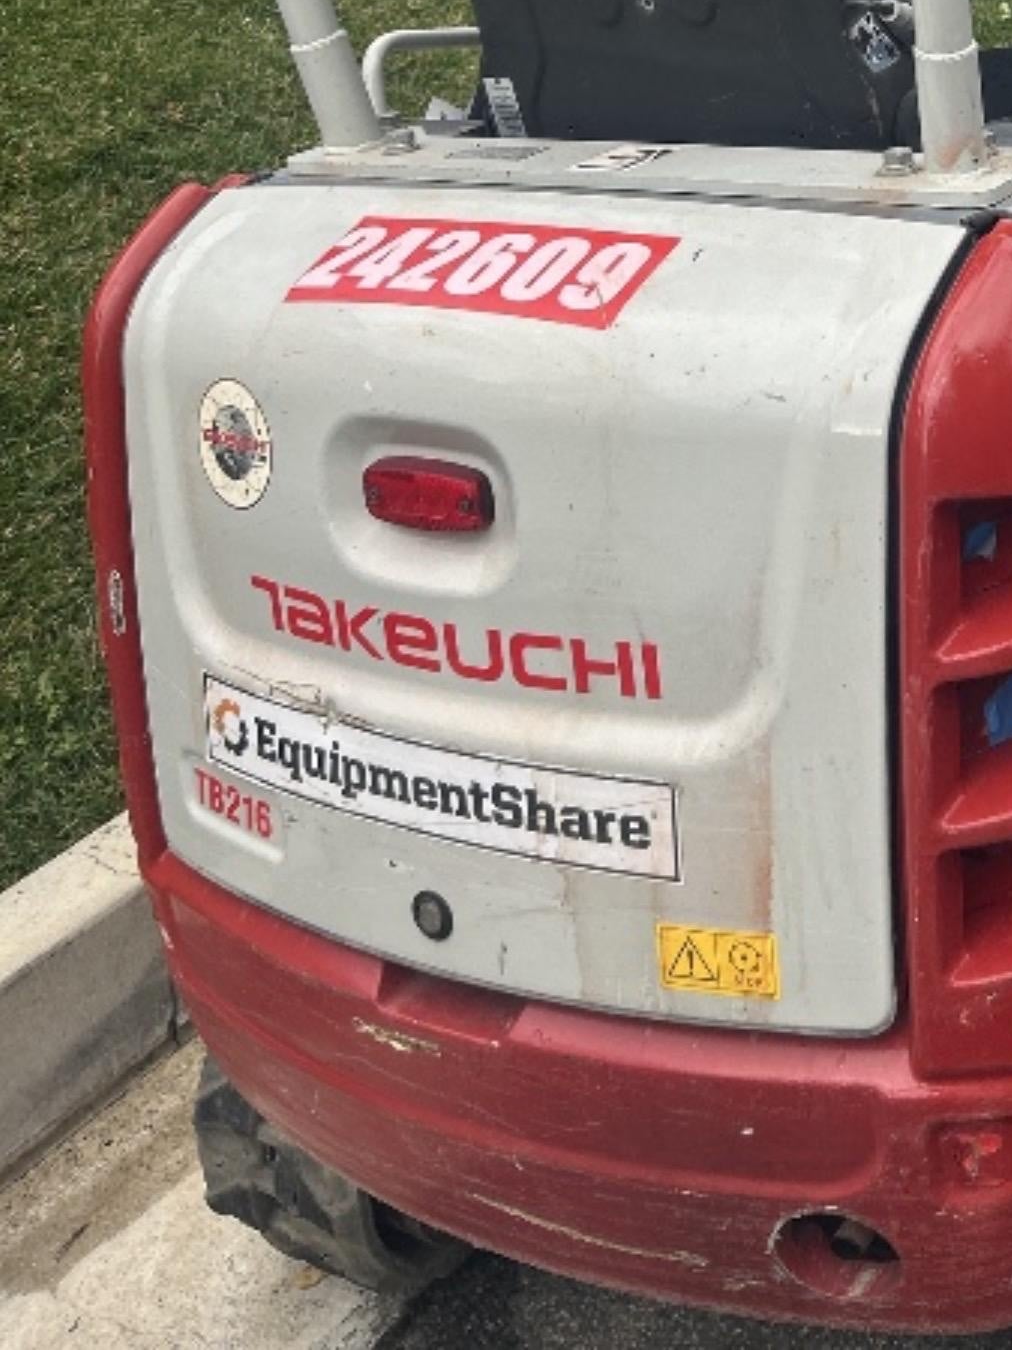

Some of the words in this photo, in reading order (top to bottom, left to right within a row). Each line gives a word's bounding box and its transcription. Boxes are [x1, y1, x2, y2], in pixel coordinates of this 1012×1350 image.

[299, 226, 652, 311] 242609
[194, 767, 273, 839] TB216
[254, 716, 652, 849] EquipmentShare
